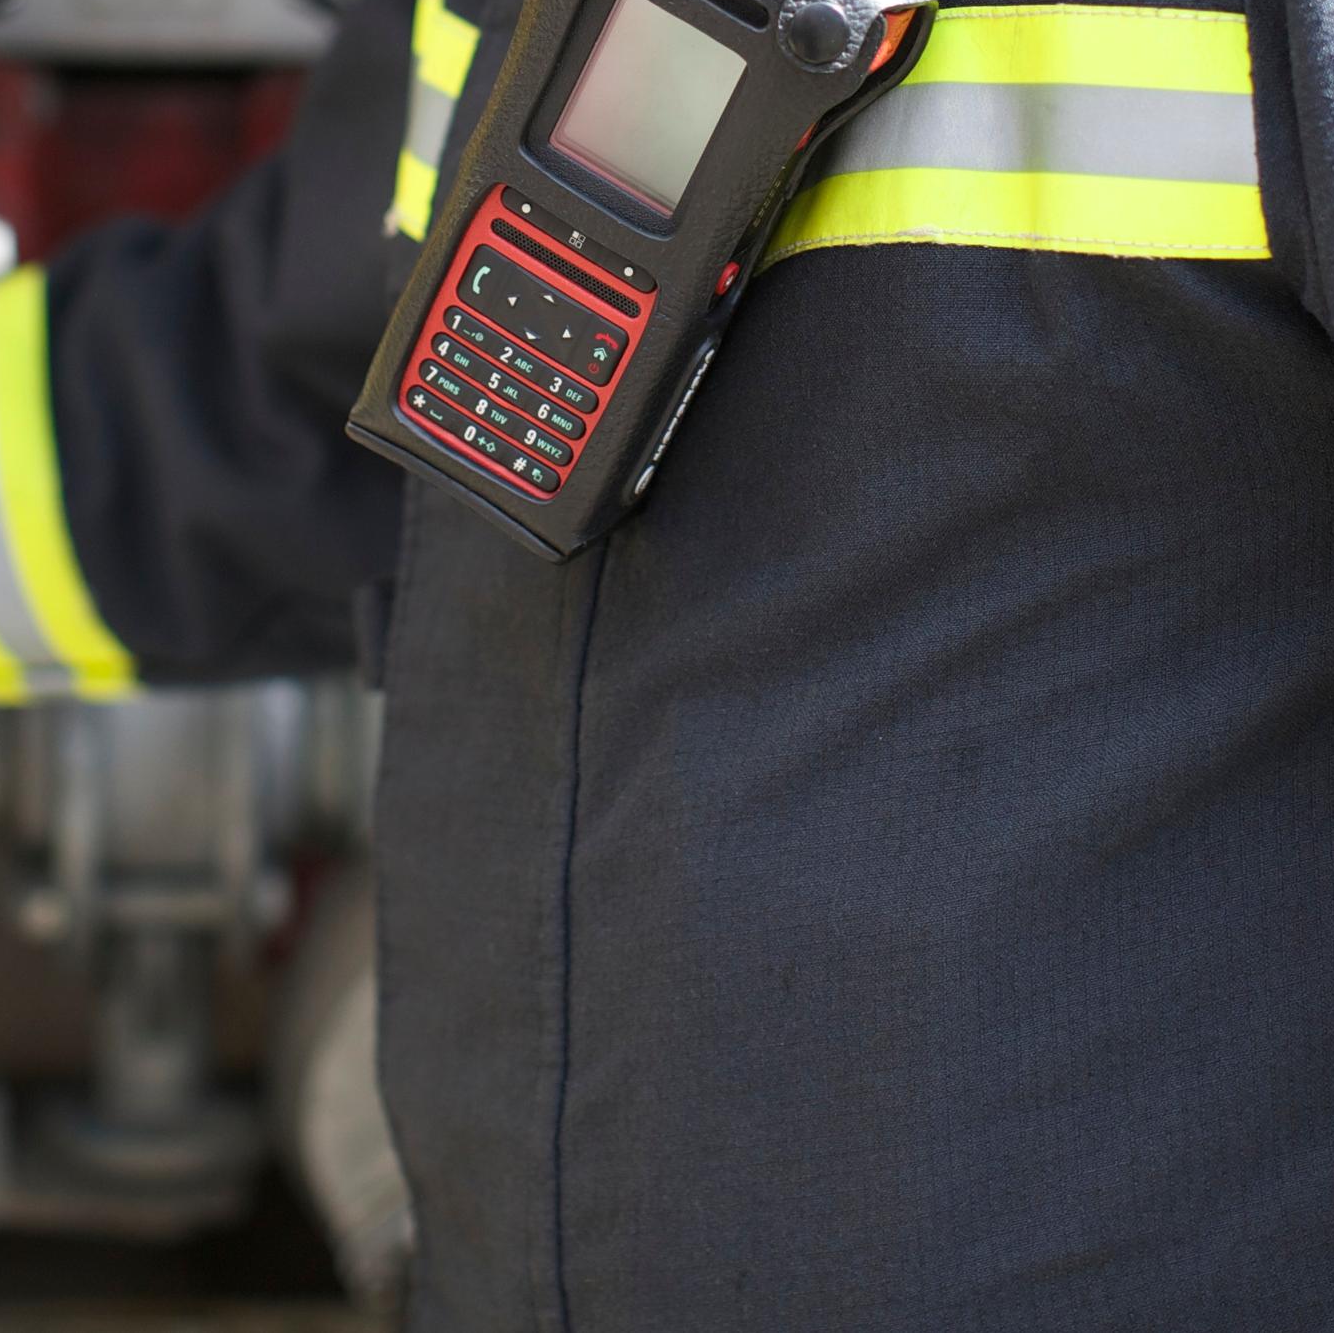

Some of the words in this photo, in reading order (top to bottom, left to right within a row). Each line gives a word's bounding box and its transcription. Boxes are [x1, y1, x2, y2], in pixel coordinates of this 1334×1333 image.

[438, 340, 449, 357] 4
[454, 353, 470, 367] GHI
[488, 373, 501, 389] 5
[503, 385, 518, 400] JKL
[537, 404, 550, 419] 6
[551, 413, 573, 431] MNO
[451, 315, 461, 330] 1
[500, 346, 513, 363] 2
[514, 357, 533, 373] ABC
[549, 377, 562, 393] 3
[565, 389, 583, 403] DEF
[425, 366, 439, 381] 7
[438, 377, 461, 396] PQRS
[476, 399, 488, 415] 8
[490, 409, 508, 425] TUV
[524, 430, 537, 445] 9
[537, 438, 563, 459] WXYZ
[464, 426, 477, 441] 0
[513, 457, 527, 472] #
